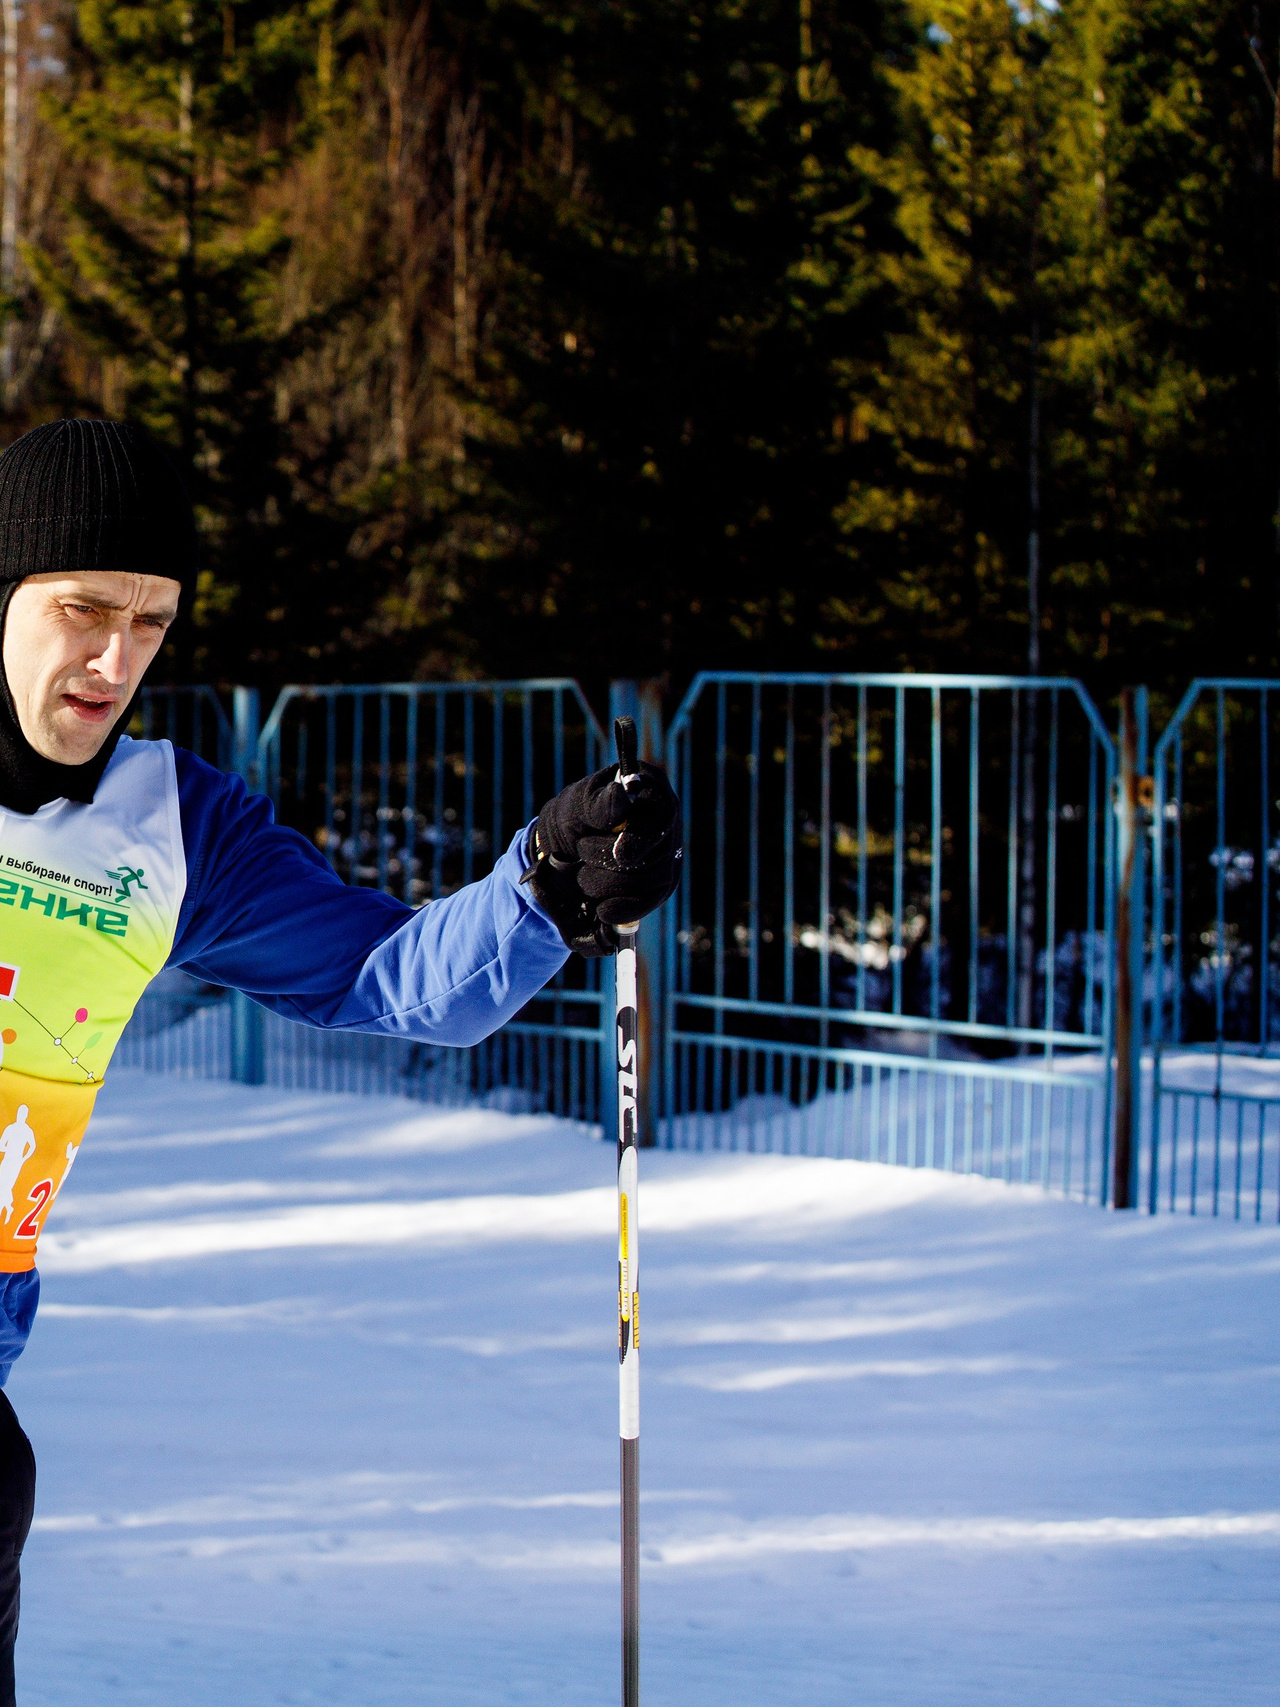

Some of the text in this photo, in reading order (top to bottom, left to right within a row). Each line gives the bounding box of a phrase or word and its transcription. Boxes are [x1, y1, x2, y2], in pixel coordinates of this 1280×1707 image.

[6, 857, 71, 884] выбираем
[74, 878, 113, 897] спорт!
[14, 1178, 53, 1240] 2
